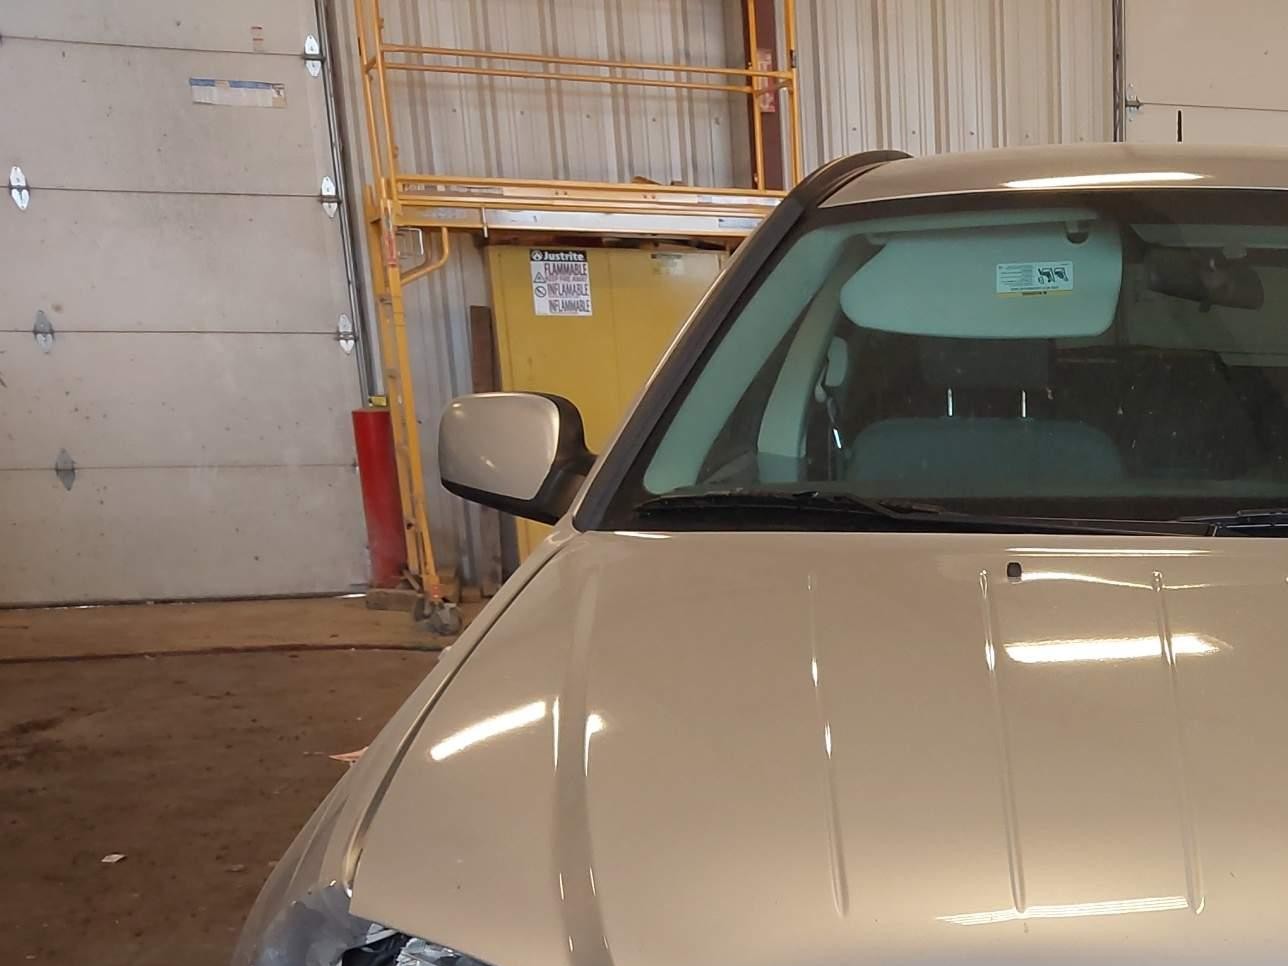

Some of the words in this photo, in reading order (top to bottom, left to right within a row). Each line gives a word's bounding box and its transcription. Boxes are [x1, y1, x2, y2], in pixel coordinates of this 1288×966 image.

[544, 251, 584, 261] Justrite
[544, 263, 587, 275] FLAMMABLE
[547, 283, 589, 296] INFLAMABLE
[549, 299, 591, 312] INFLAMMABLE
